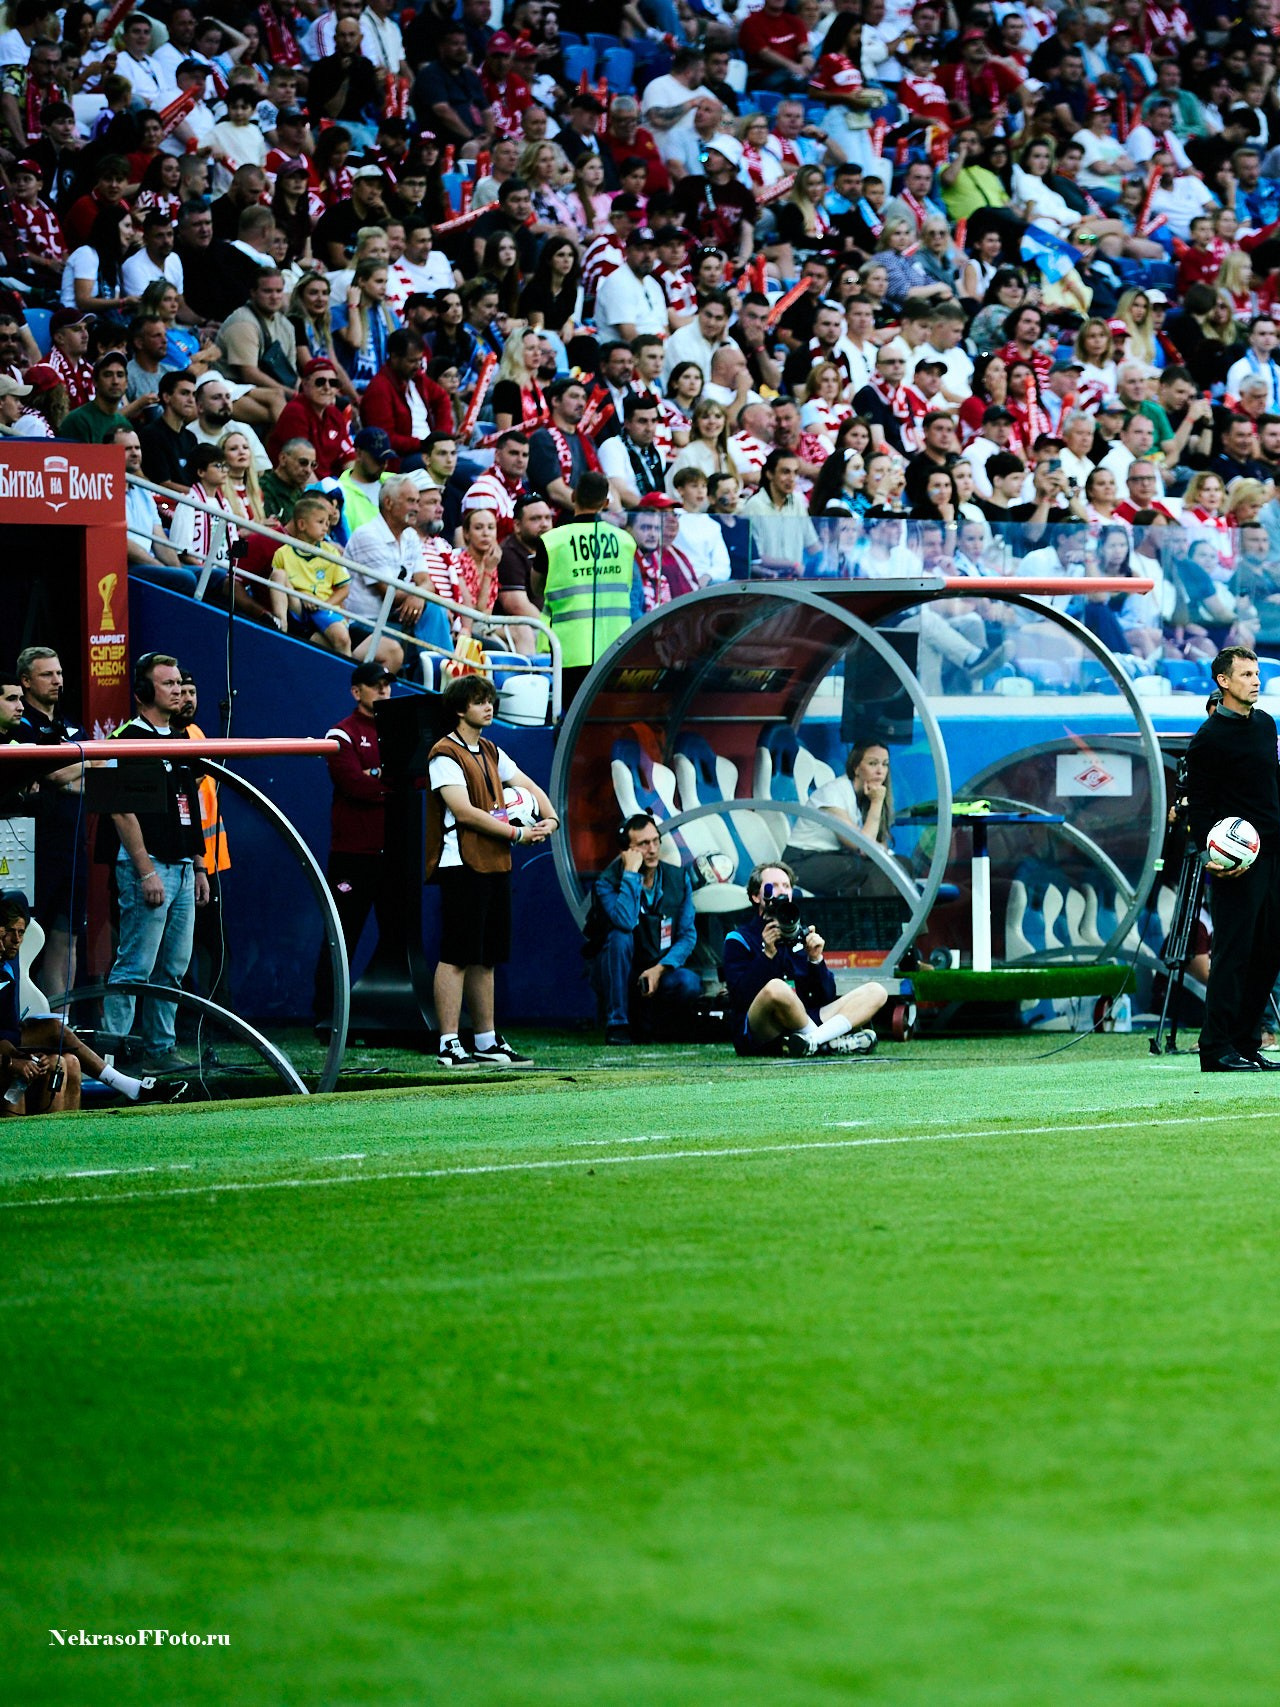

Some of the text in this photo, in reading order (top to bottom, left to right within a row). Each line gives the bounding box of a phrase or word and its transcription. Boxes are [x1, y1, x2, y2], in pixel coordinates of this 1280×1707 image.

[570, 533, 618, 561] 16020
[572, 566, 621, 577] STEWARD
[90, 634, 125, 644] OLIMPBET
[91, 645, 125, 660] СУПЕР
[91, 661, 125, 676] КУБОК
